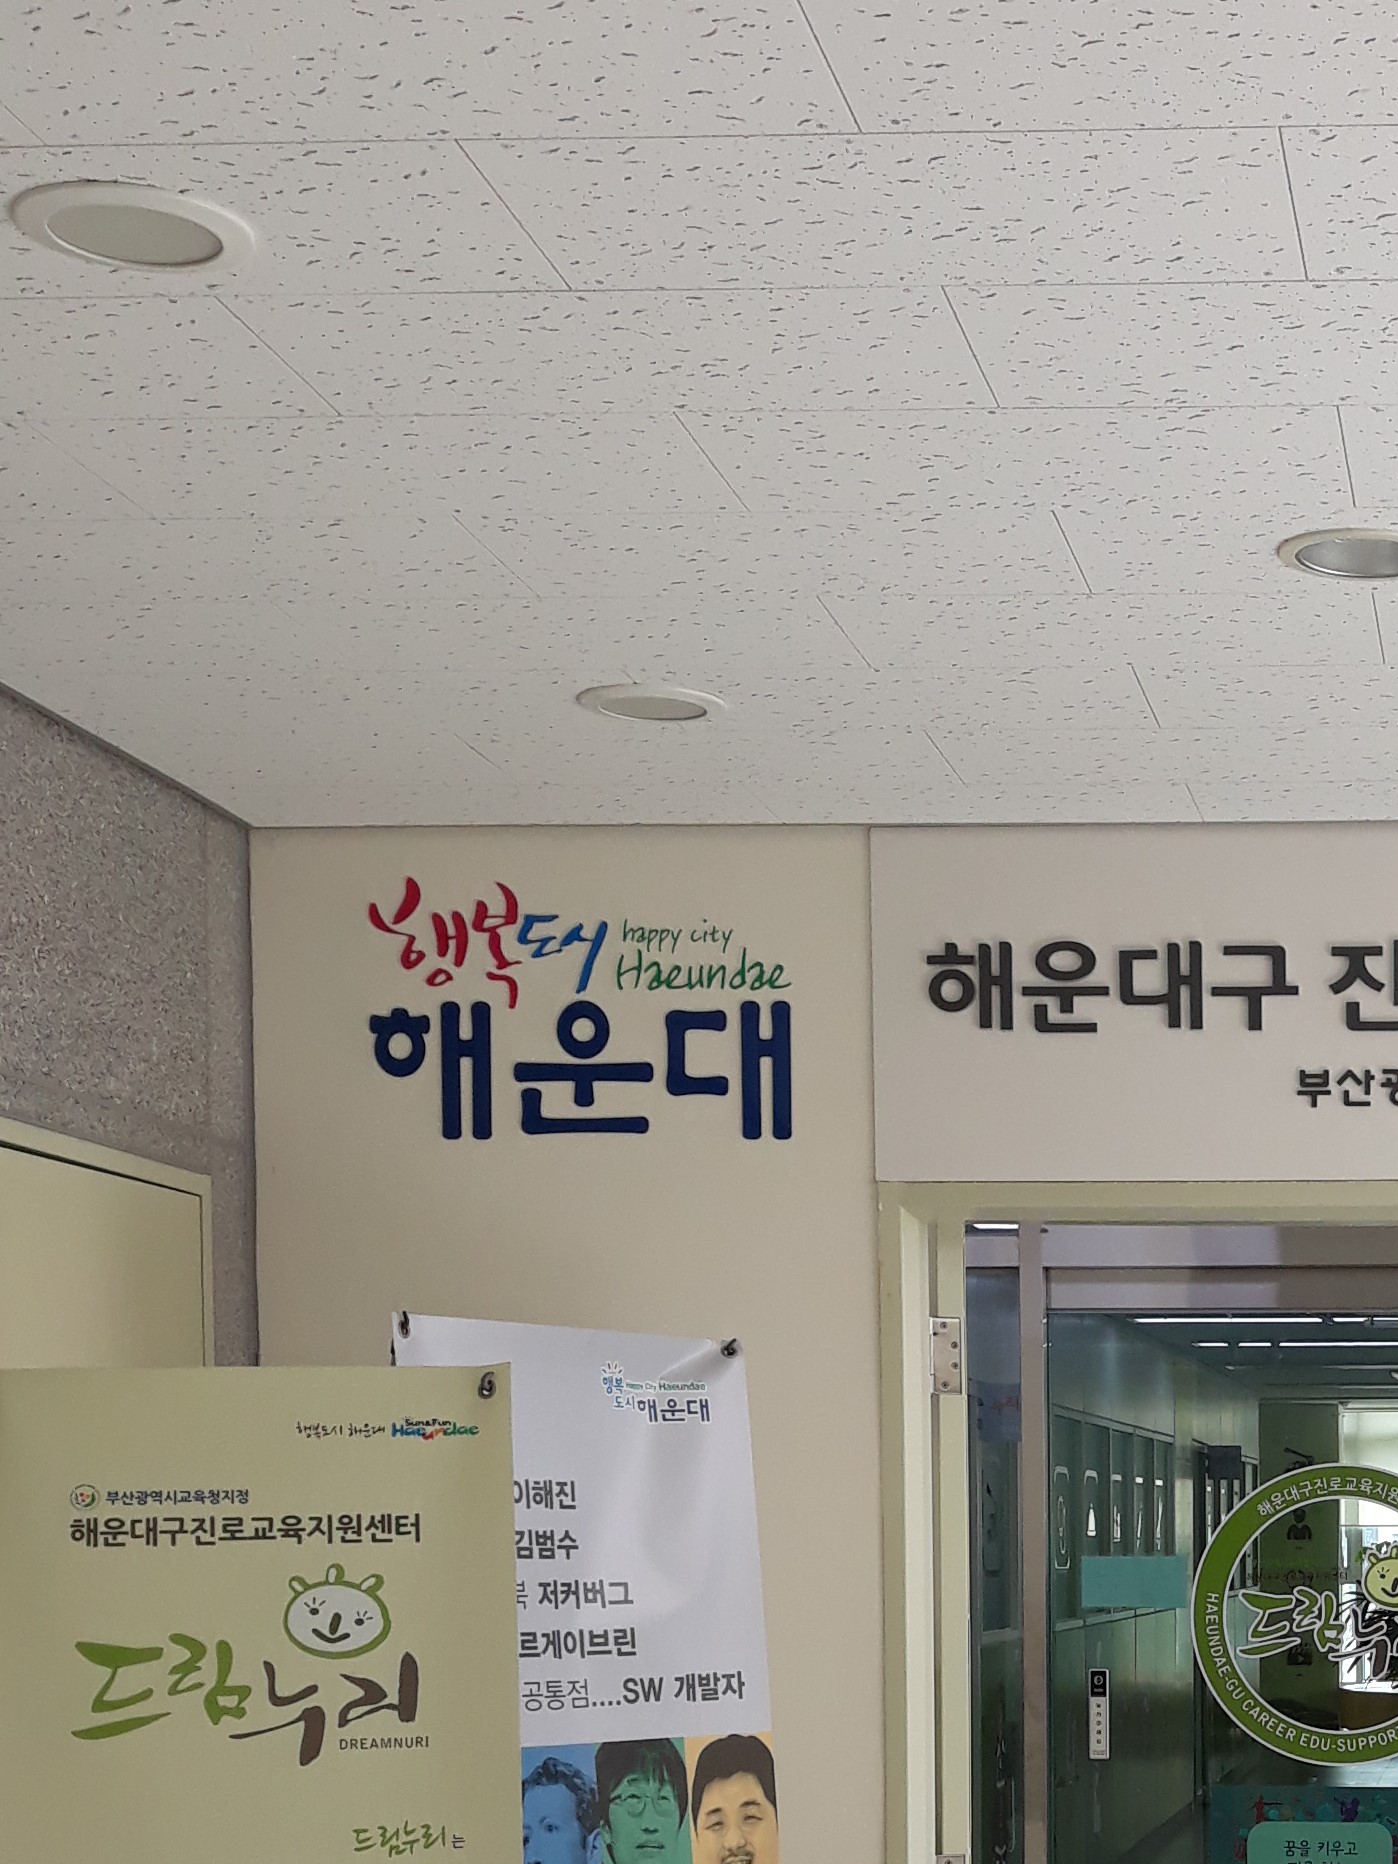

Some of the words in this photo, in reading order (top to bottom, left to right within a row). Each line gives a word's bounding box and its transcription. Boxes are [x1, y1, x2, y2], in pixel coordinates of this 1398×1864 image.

[368, 877, 608, 1010] 행복도시
[622, 919, 682, 954] happy
[690, 919, 735, 949] city
[616, 948, 791, 991] Haeundae
[925, 938, 1299, 1034] 해운대구
[369, 1000, 792, 1140] 해운대
[637, 1398, 711, 1422] 해운대
[348, 1423, 385, 1437] 해운대
[105, 1488, 250, 1506] 부산광역시교육청지정
[514, 1478, 578, 1511] 이해진
[69, 1513, 422, 1548] 해운대구진로교육지원센터
[515, 1528, 579, 1561] 김범수
[538, 1580, 634, 1610] 저커버그
[1205, 1593, 1246, 1699] HAEUNDAE-GU
[1242, 1699, 1295, 1741] CAREER
[70, 1633, 420, 1768] 드림누리
[673, 1670, 746, 1704] 개발자
[339, 1736, 430, 1752] DREAMNURI
[1284, 1840, 1310, 1858] 꿈을
[1318, 1839, 1359, 1857] 키우고
